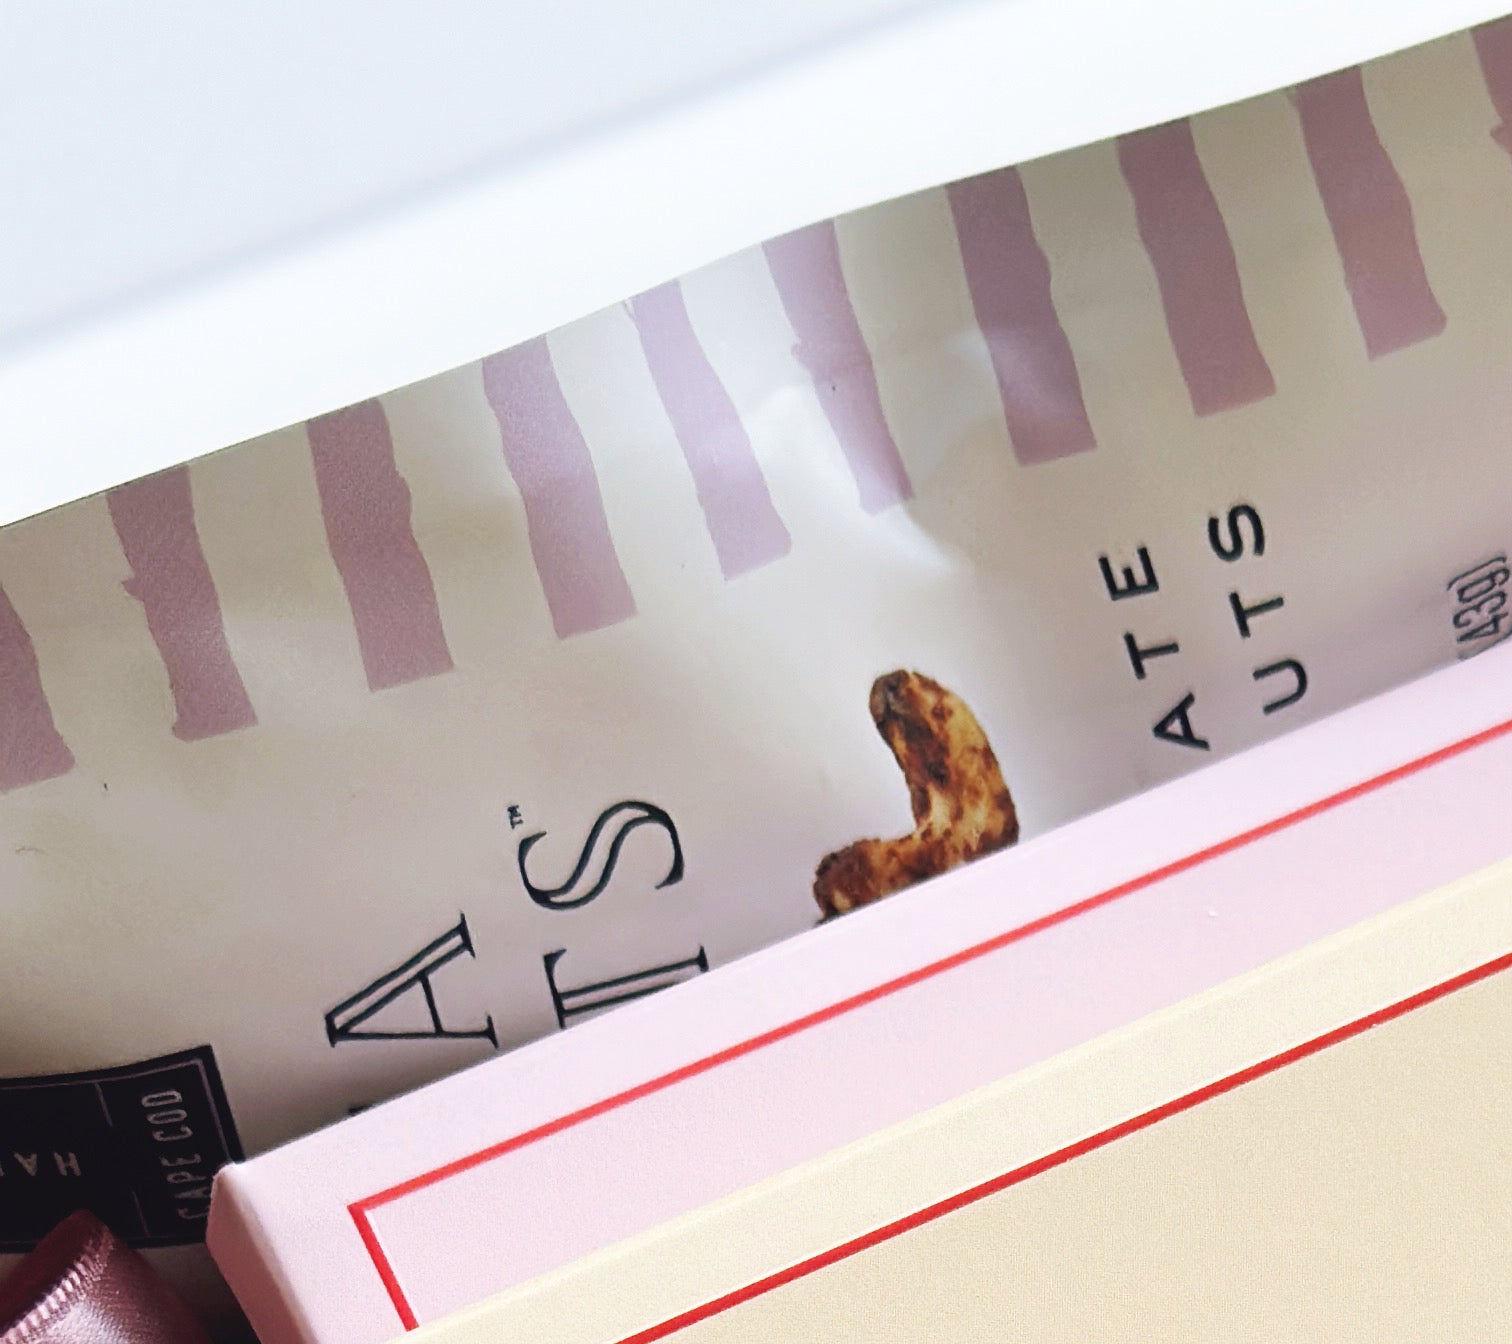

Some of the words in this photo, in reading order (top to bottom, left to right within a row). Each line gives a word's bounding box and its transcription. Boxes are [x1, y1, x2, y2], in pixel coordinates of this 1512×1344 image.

[1099, 546, 1211, 752] ATE
[1208, 503, 1308, 716] UTS
[141, 1089, 193, 1142] COD
